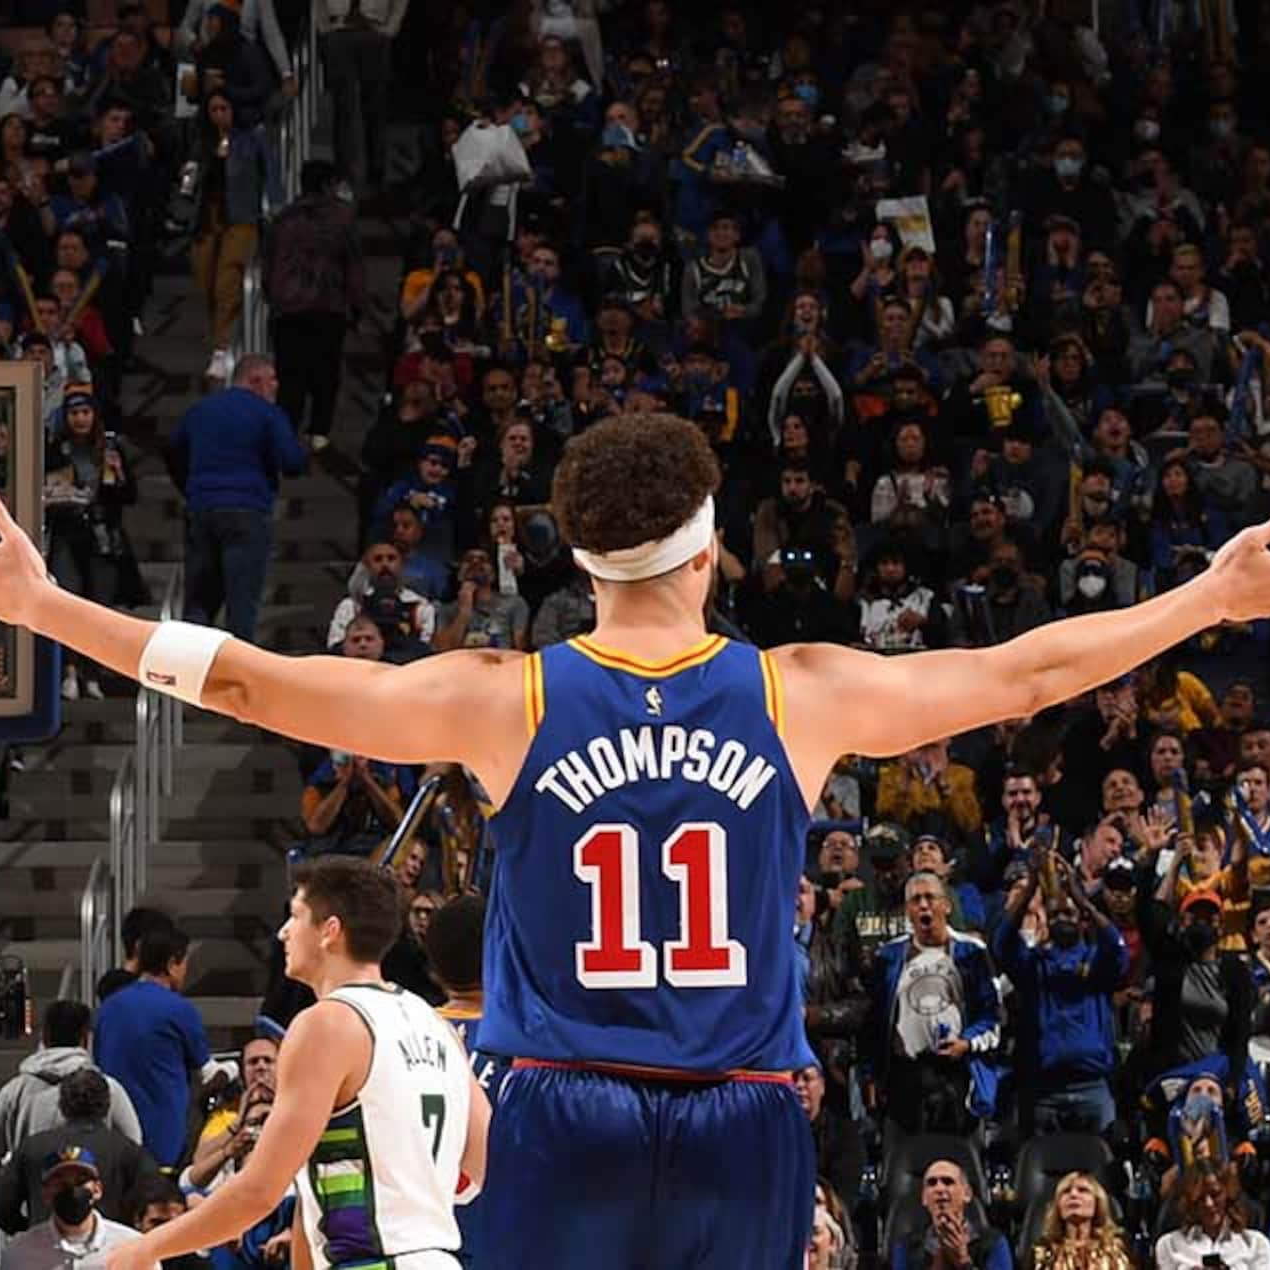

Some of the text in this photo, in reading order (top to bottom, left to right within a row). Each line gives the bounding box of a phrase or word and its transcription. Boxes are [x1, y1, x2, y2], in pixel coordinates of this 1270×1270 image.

[535, 725, 777, 814] THOMPSON
[573, 821, 747, 989] 11
[398, 1034, 447, 1072] ALLEN
[420, 1093, 445, 1166] 7
